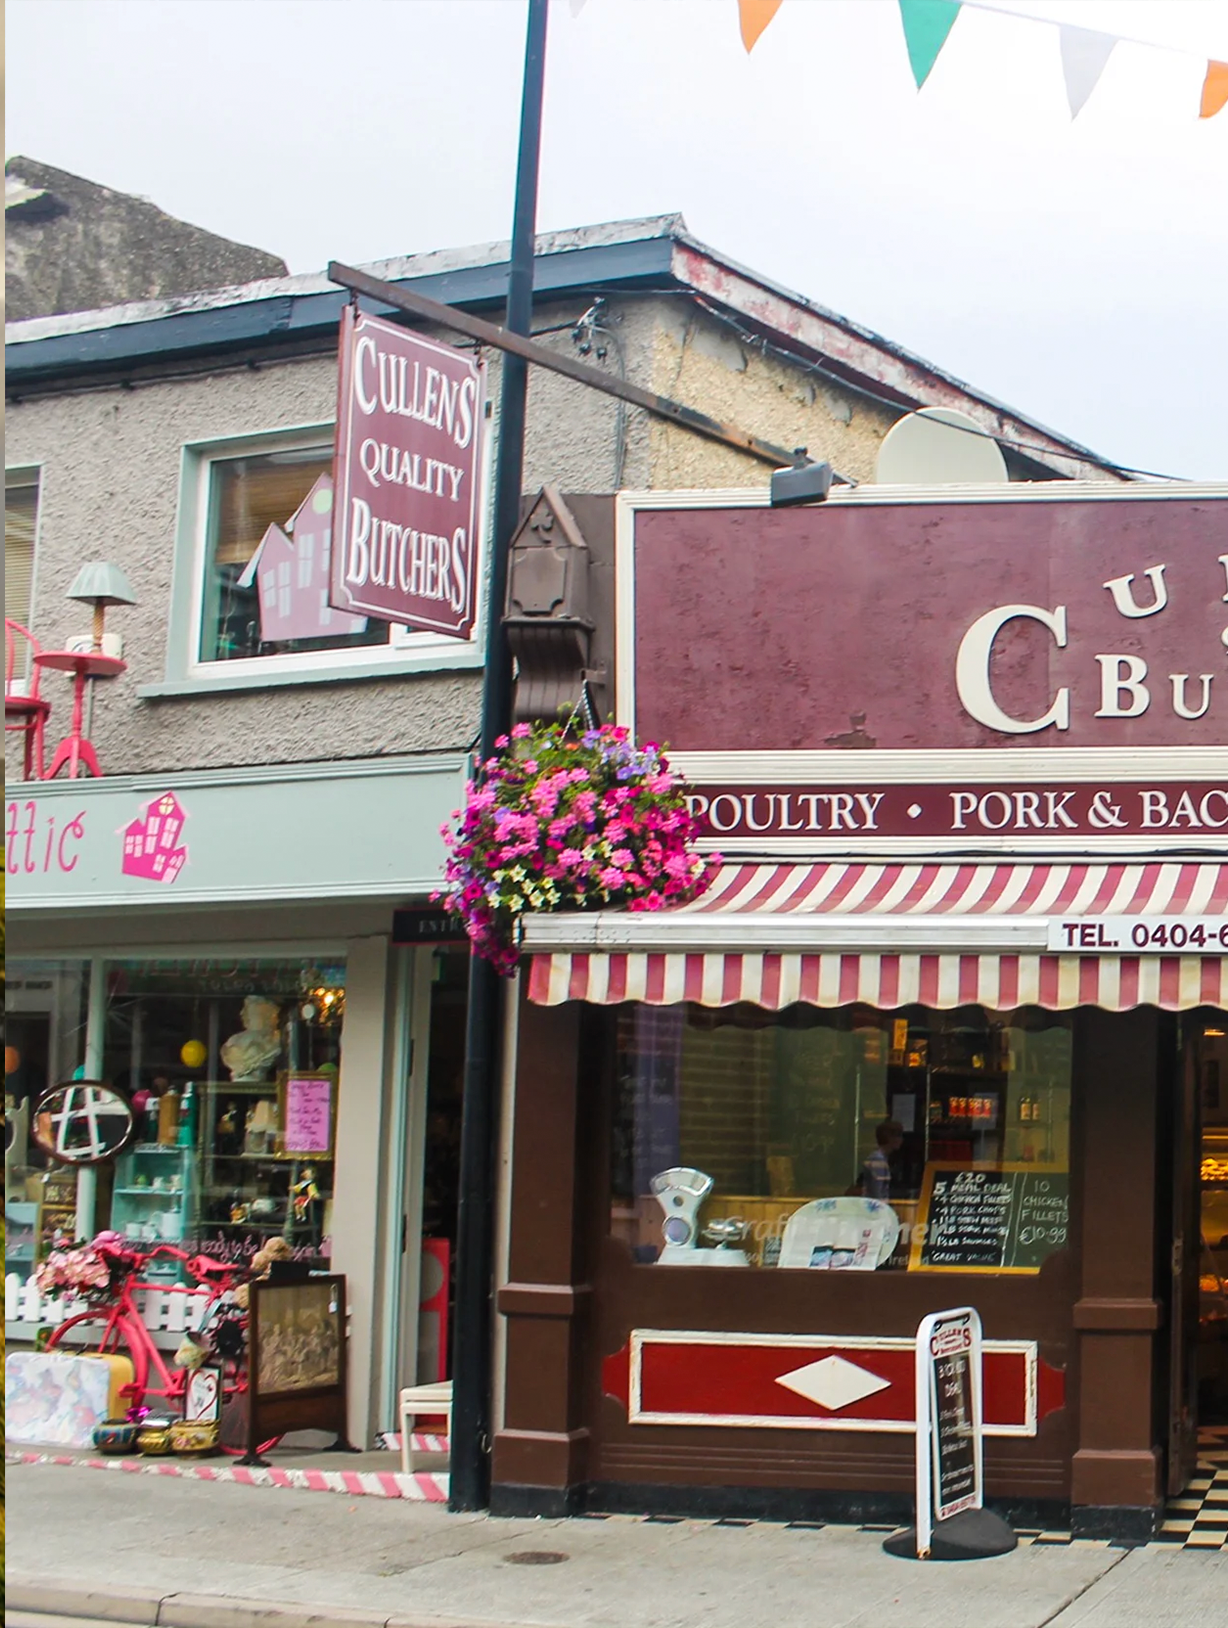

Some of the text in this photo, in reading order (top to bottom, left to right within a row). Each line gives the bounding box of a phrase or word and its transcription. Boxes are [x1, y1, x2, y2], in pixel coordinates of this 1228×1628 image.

[354, 335, 477, 449] CULLENS
[359, 438, 465, 502] QUALITY
[346, 496, 467, 615] BUTCHERS
[682, 792, 885, 832] POULTRY
[949, 790, 1078, 831] PORK
[1086, 789, 1126, 829] &
[1060, 923, 1120, 950] TEL.
[933, 1181, 948, 1196] 5
[1034, 1180, 1051, 1193] 10
[1023, 1194, 1069, 1210] CHICKEN
[1021, 1209, 1069, 1224] FILLETS
